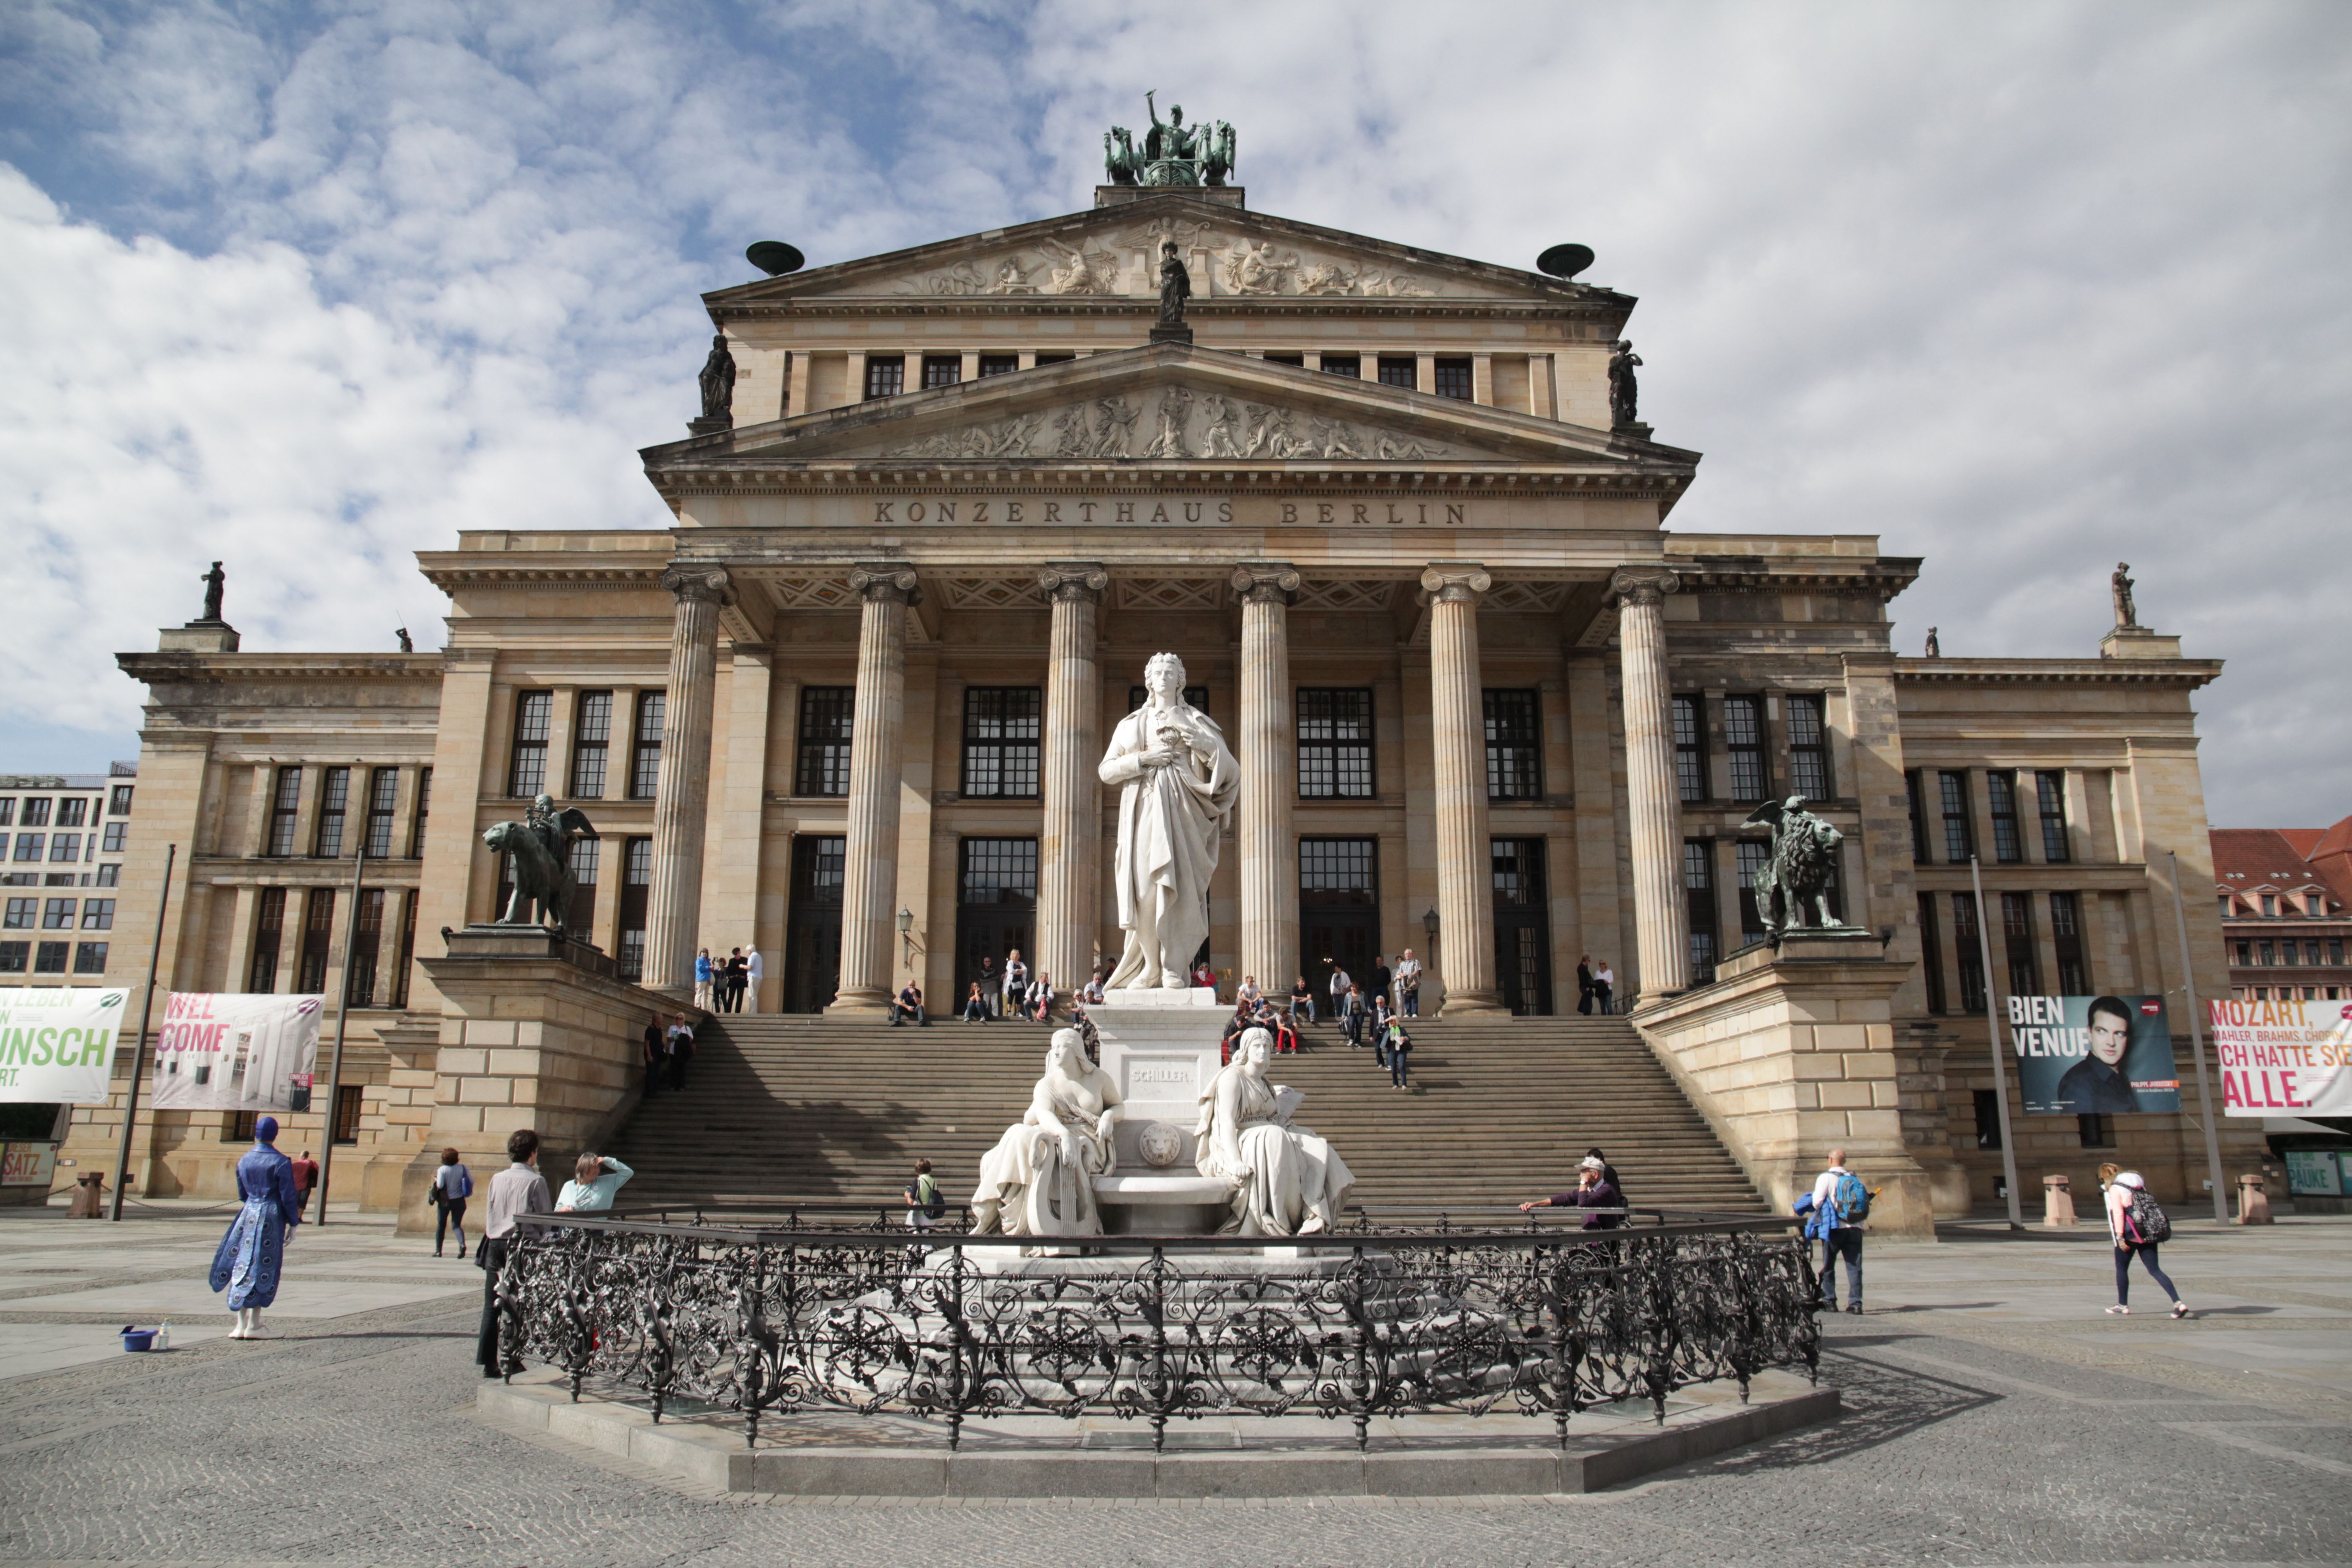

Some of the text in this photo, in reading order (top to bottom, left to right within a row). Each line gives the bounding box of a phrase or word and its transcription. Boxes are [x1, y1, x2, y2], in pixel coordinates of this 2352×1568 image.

[874, 503, 1465, 524] KONZERTHAUS BERLIN
[13, 988, 79, 1007] LEBEN
[168, 993, 214, 1019] WEL
[2008, 996, 2064, 1025] BIEN
[2207, 1000, 2314, 1029] MOZART,
[157, 1023, 230, 1052] COME
[2012, 1028, 2091, 1057] VENUE
[2212, 1031, 2343, 1042] MAHLER, BRAHMS, CHOPIN
[2215, 1045, 2352, 1067] ICH HATTE SIE
[2224, 1071, 2312, 1107] ALLE.
[3, 1153, 40, 1175] SATZ
[2288, 1169, 2329, 1188] PAUKE
